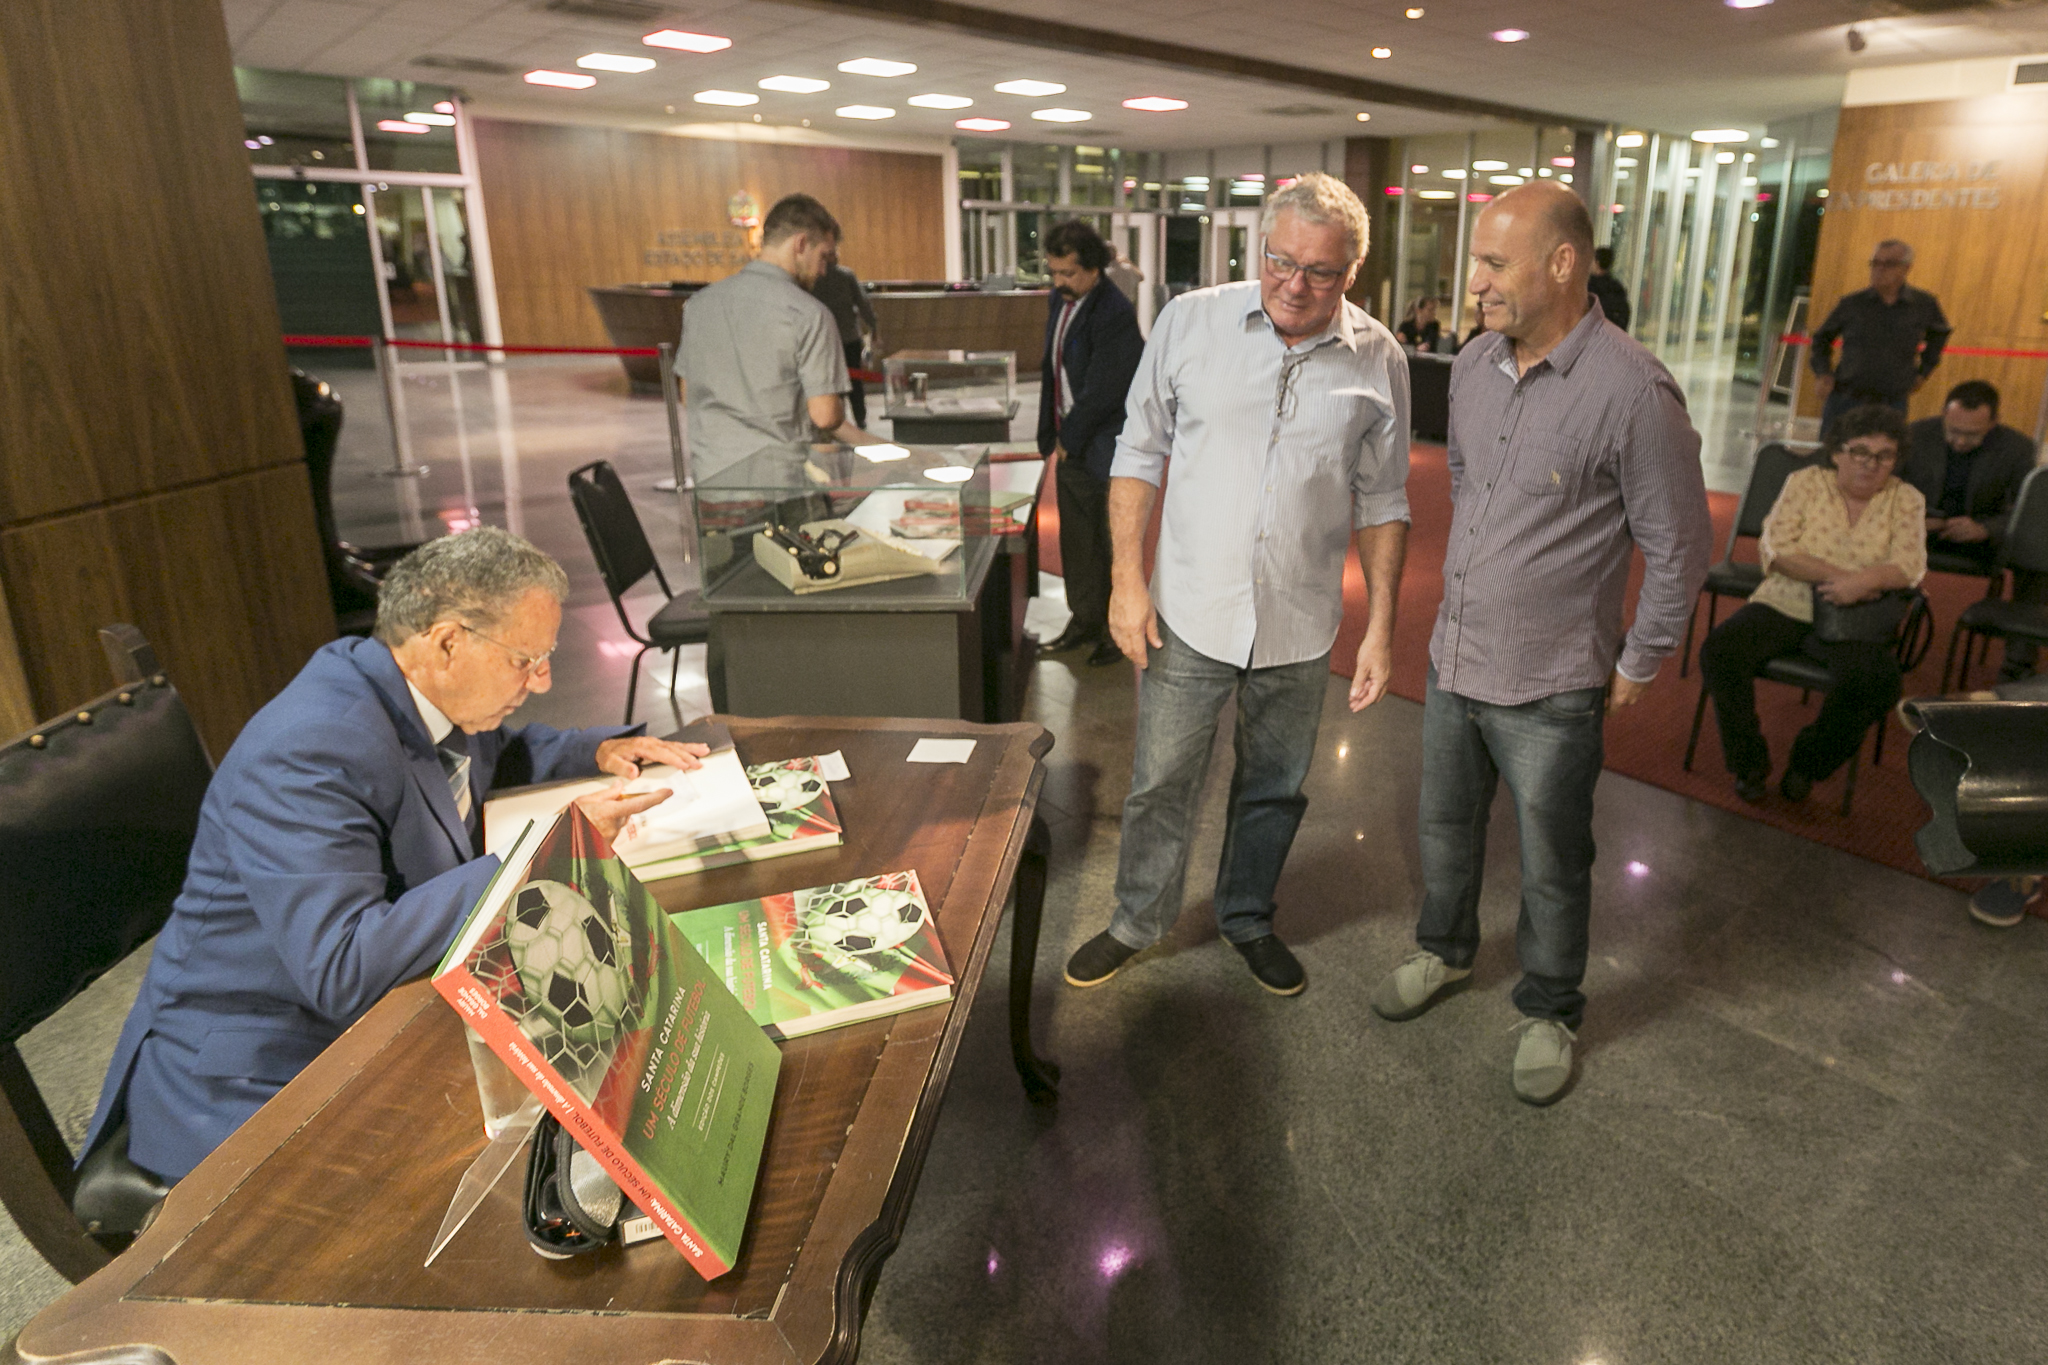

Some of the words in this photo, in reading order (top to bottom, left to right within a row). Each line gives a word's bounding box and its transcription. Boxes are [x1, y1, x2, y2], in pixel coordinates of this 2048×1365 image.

[757, 921, 769, 948] SANTA
[759, 948, 773, 991] CATARINA
[641, 1047, 664, 1093] SANTA
[659, 986, 687, 1045] CATARINA
[691, 1041, 701, 1061] sua
[643, 1111, 660, 1140] UM
[653, 1052, 680, 1112] SÉCULO
[674, 1030, 688, 1053] DE
[681, 979, 707, 1032] FUTEBOL
[685, 1057, 696, 1074] da
[670, 1070, 692, 1119] dimensão
[572, 1112, 605, 1147] FUTEBOL
[666, 1114, 677, 1131] A
[601, 1147, 614, 1158] DE
[639, 1187, 651, 1199] UM
[681, 1233, 703, 1258] SANTA
